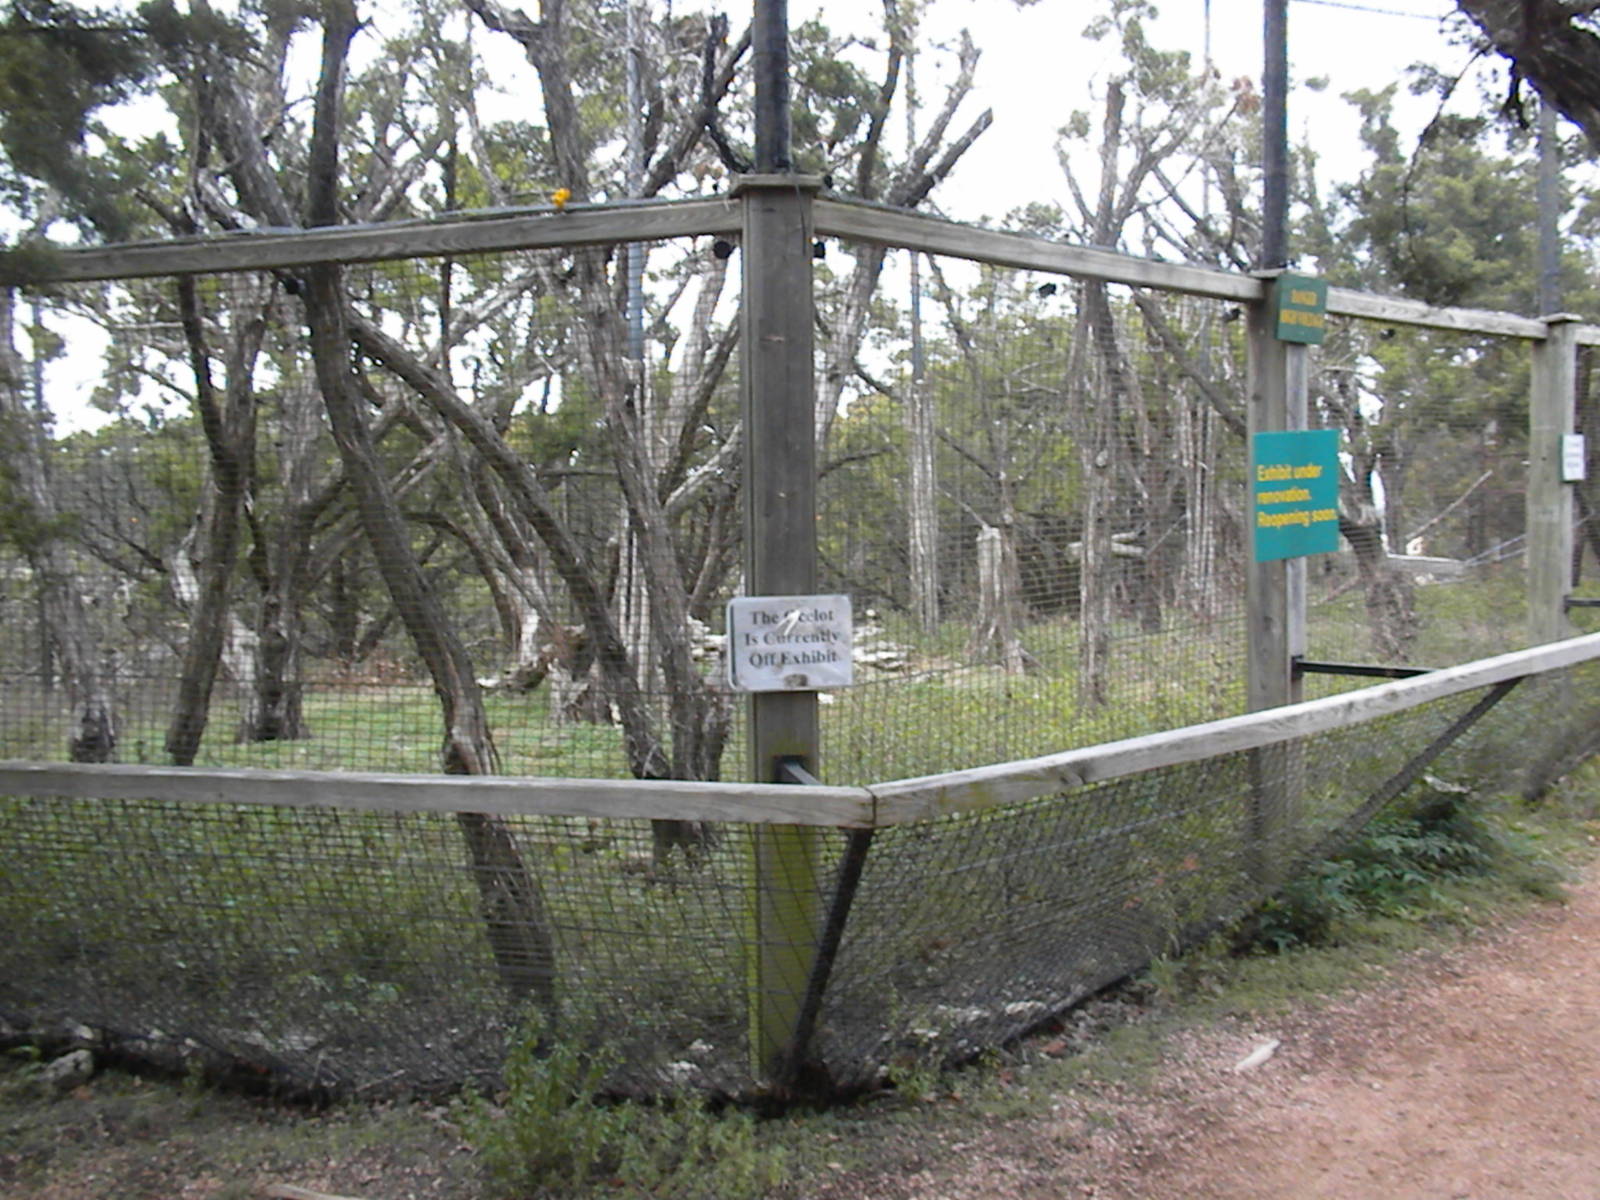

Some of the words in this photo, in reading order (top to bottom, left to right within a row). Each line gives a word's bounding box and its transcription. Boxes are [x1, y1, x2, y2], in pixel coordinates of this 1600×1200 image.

[751, 611, 779, 625] The
[744, 632, 758, 647] Is
[763, 629, 839, 645] Currently
[749, 652, 776, 668] Off
[780, 650, 837, 666] Exhibit
